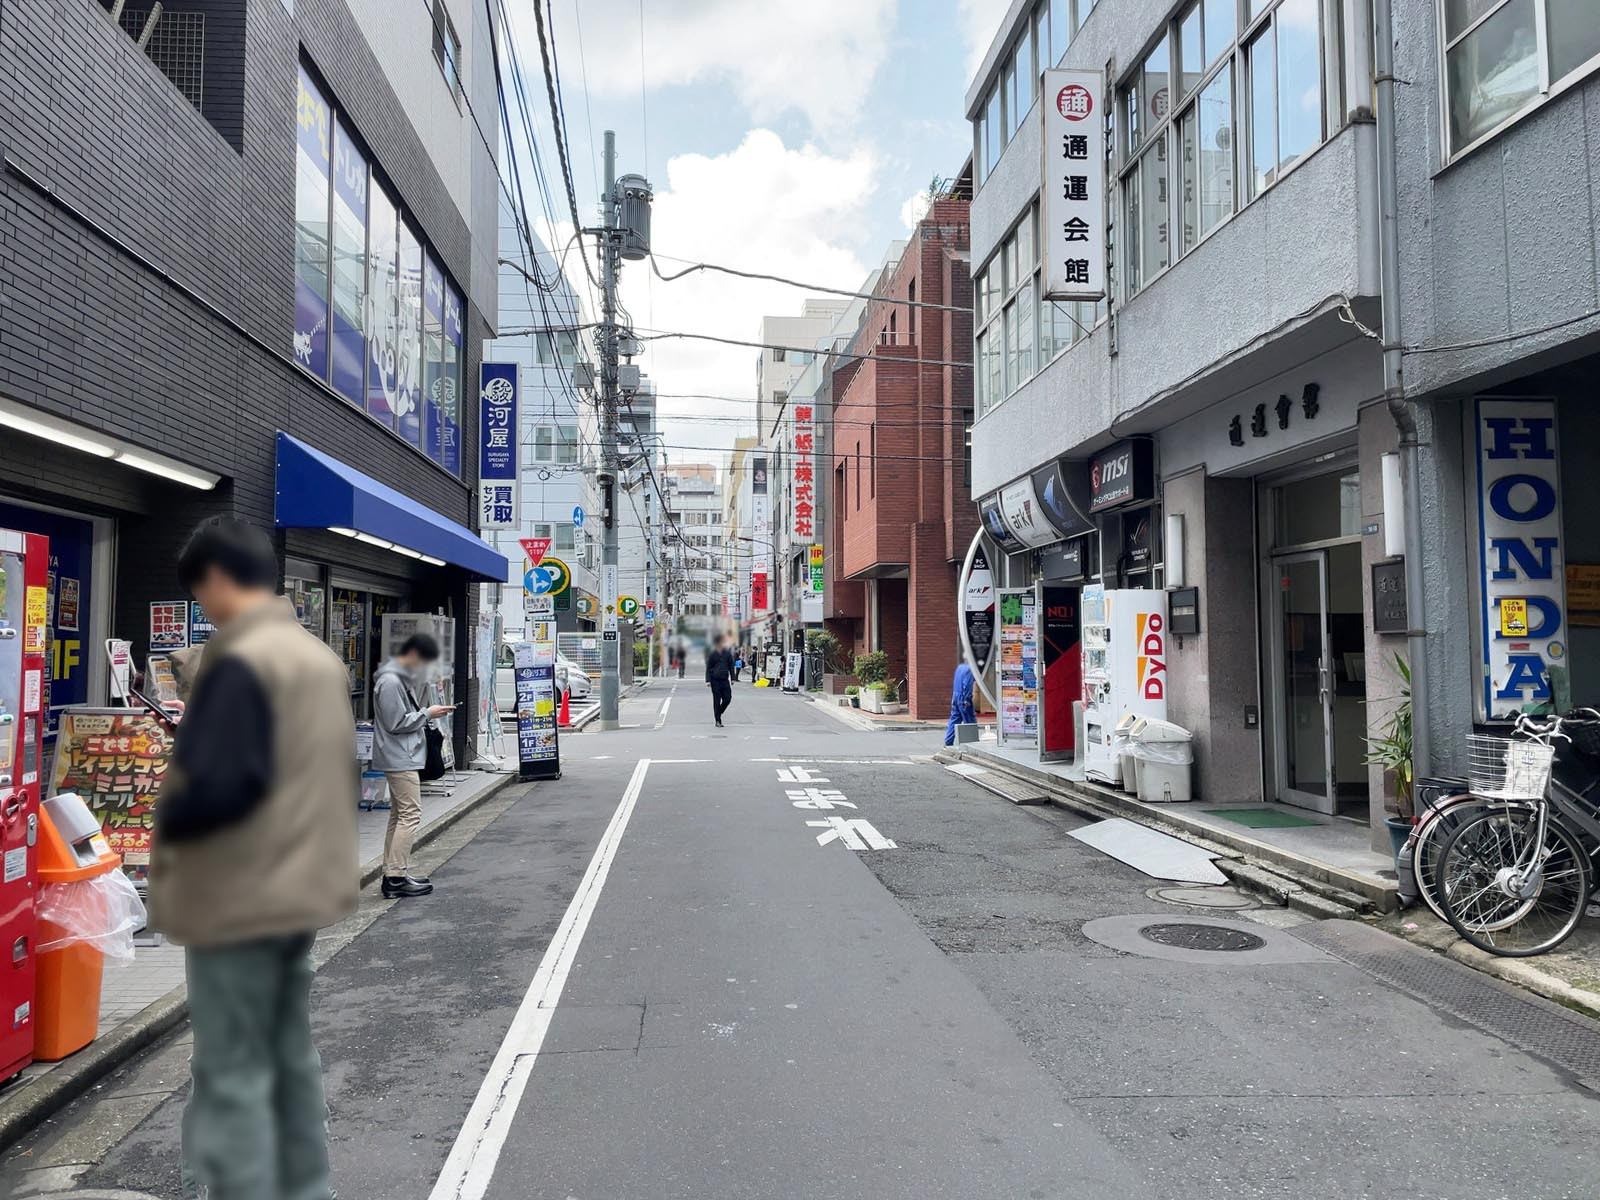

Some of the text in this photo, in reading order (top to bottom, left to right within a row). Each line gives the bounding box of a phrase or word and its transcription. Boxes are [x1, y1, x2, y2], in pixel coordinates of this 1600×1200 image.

[1062, 134, 1090, 284] 通運会館
[485, 377, 514, 449] 駿河屋
[794, 405, 814, 537] 第一紙工株式会社
[1102, 453, 1130, 485] msi
[483, 486, 493, 523] センター
[493, 486, 513, 523] 買取
[1011, 508, 1030, 530] ark
[1484, 417, 1561, 701] HONDA
[625, 600, 635, 612] P
[968, 586, 983, 594] ark
[52, 639, 81, 680] 1F
[1144, 612, 1167, 700] DyDo
[519, 692, 533, 702] 2F
[87, 736, 130, 753] こども
[521, 738, 535, 748] 1F
[71, 755, 168, 775] トイラジコン
[776, 765, 900, 851] 止まれ
